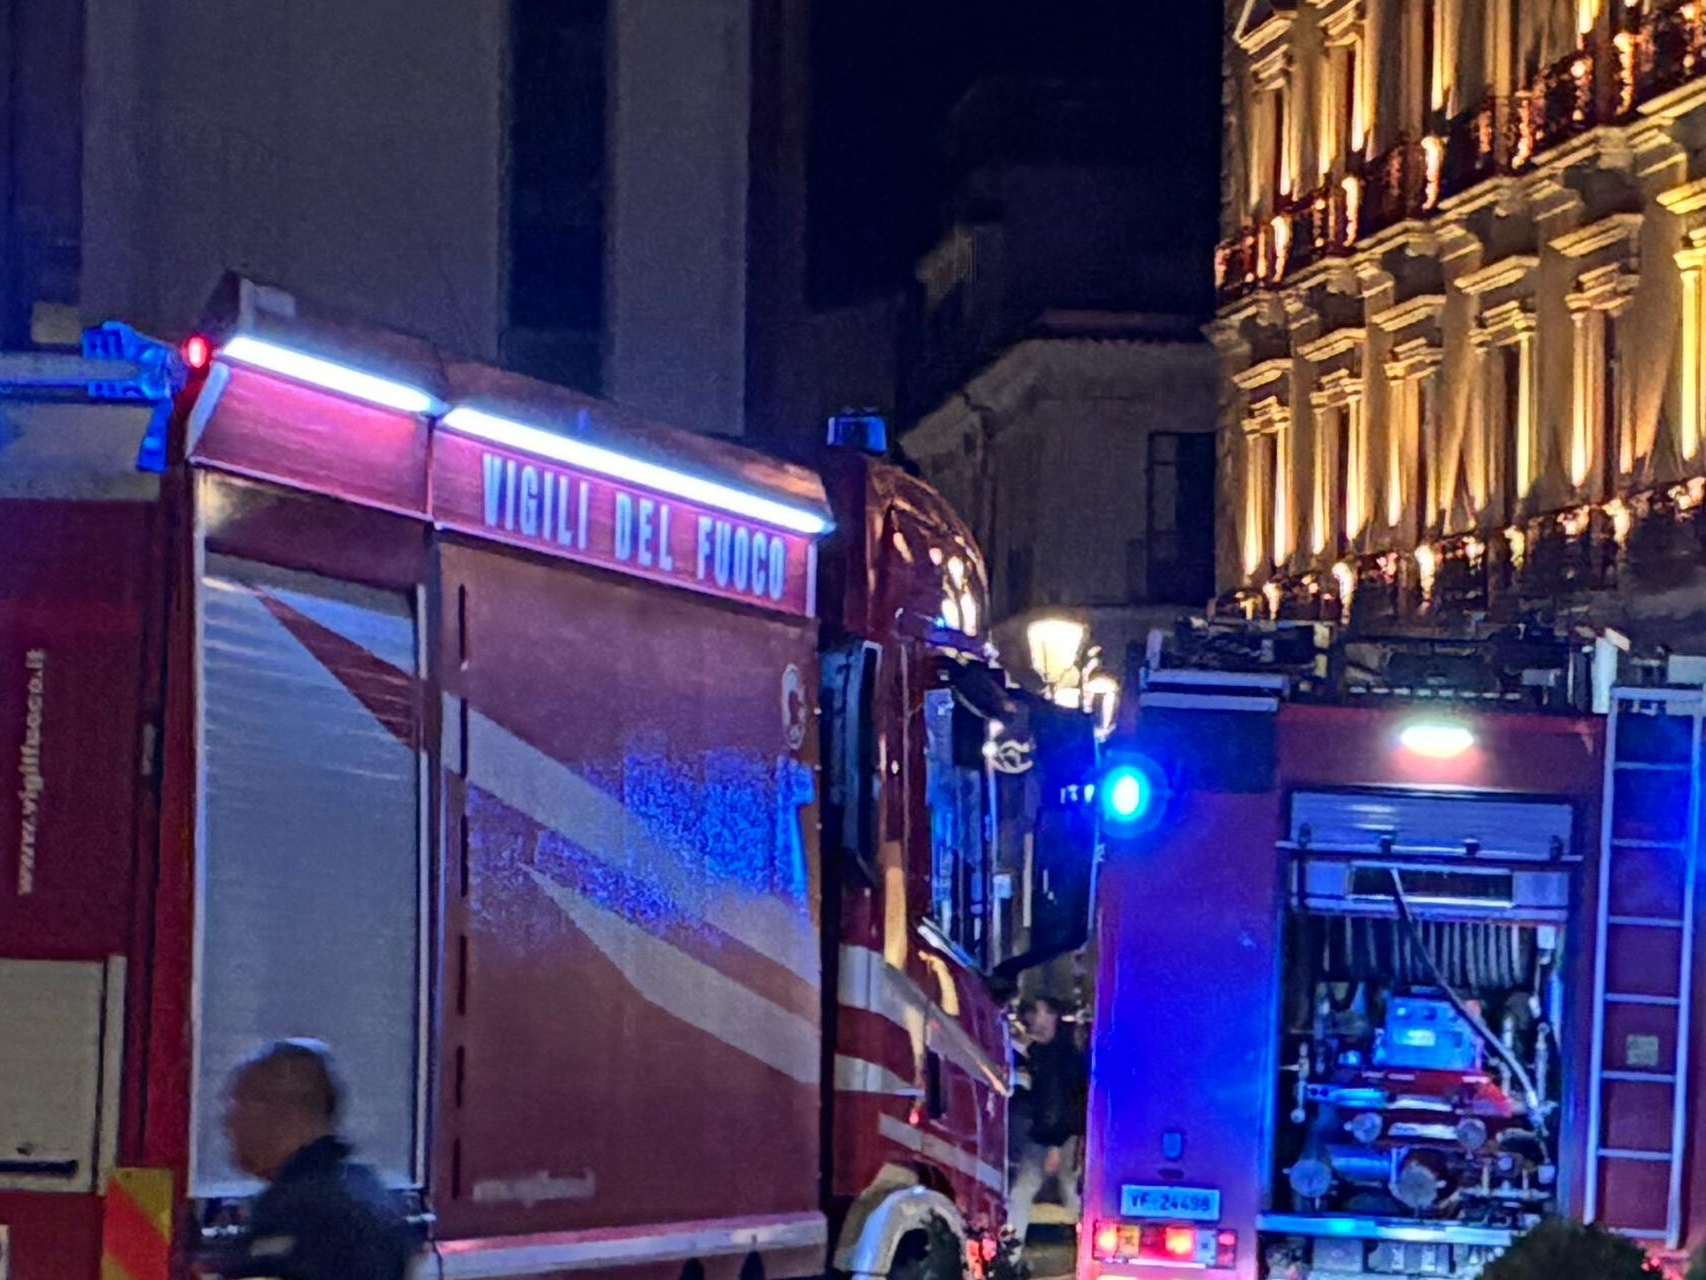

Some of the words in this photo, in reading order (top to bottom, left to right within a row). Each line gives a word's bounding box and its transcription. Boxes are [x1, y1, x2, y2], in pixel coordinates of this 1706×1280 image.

[482, 452, 590, 551] VIGILI
[614, 491, 673, 571] DEL
[696, 516, 786, 601] FUOCO
